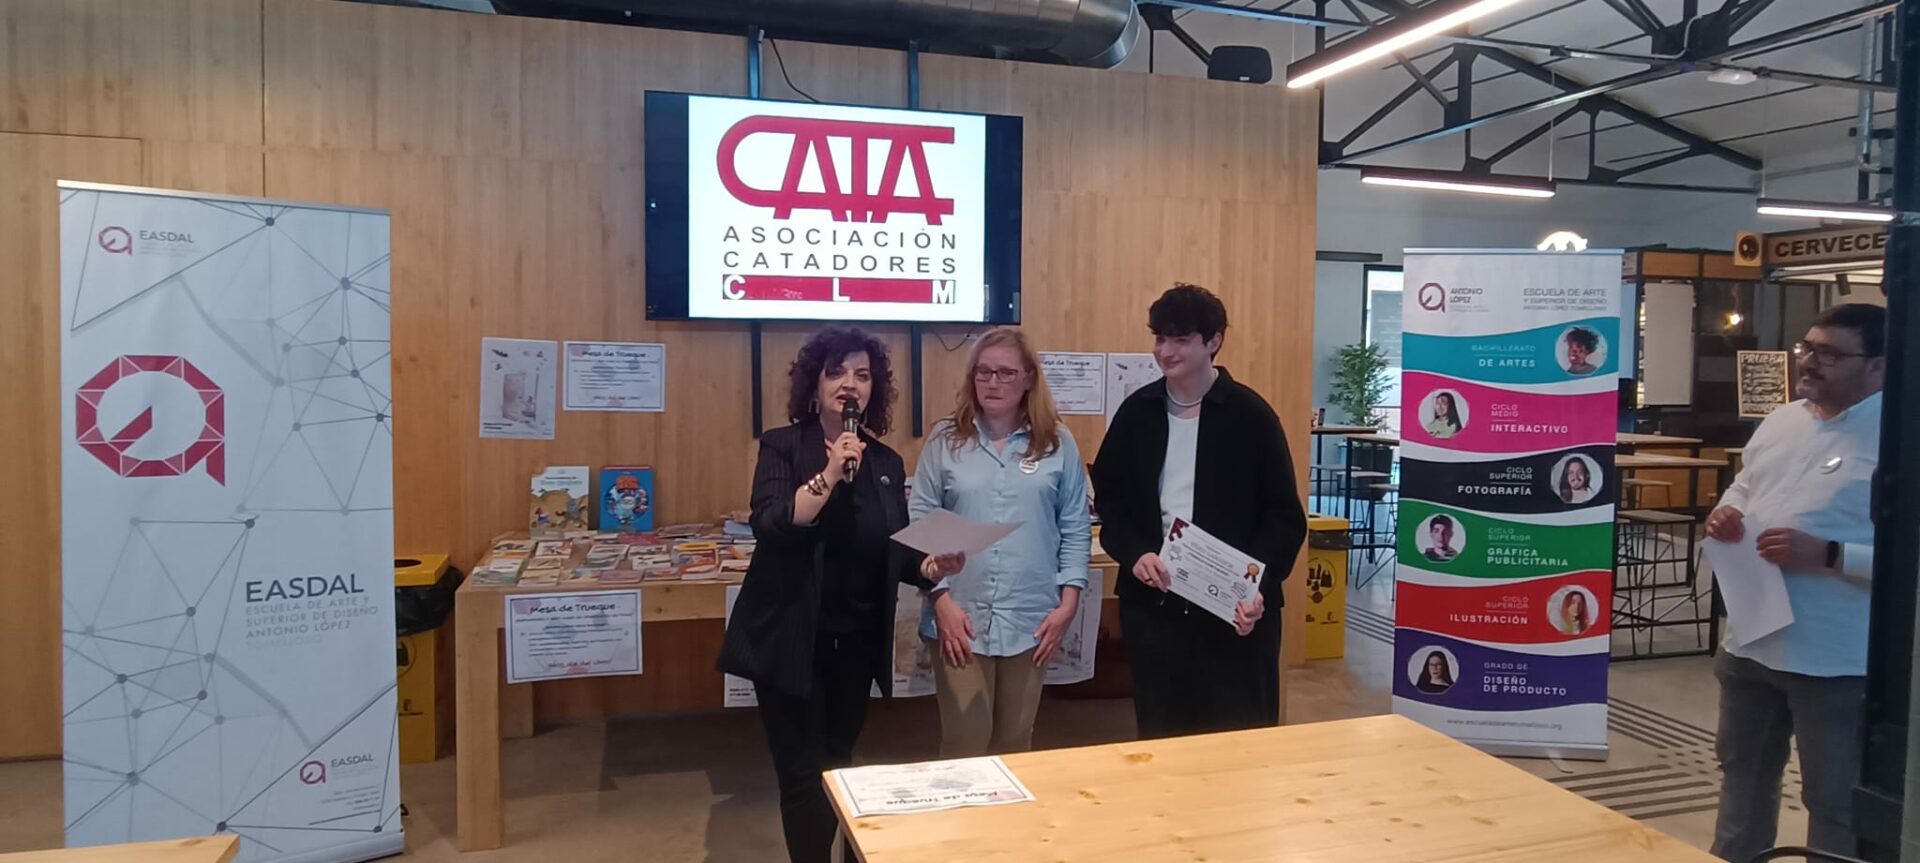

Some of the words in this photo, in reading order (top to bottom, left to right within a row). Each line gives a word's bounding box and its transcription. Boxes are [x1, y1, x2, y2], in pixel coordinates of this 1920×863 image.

[716, 114, 955, 225] CATA
[139, 230, 195, 244] EASDAL
[722, 225, 956, 249] ASOCIACIÓN
[1774, 232, 1886, 258] CERVECE
[722, 251, 956, 274] CATADORES
[1450, 287, 1483, 295] ANTONIO
[1523, 287, 1565, 296] ESCUELA
[1567, 287, 1580, 296] DE
[1582, 287, 1608, 297] ARTE
[1472, 344, 1537, 352] BACHILLERATO
[1479, 358, 1495, 367] DE
[1499, 359, 1536, 368] ARTES
[1490, 424, 1569, 434] INTERACTIVO
[1506, 466, 1533, 474] CICLO
[1489, 473, 1533, 481] SUPERIOR
[1457, 484, 1532, 496] FOTOGRAFÍA
[1488, 534, 1531, 542] SUPERIOR
[1487, 546, 1539, 557] GRÁFICA
[1487, 556, 1569, 567] PUBLICITARIA
[245, 572, 365, 603] EASDAL
[245, 601, 302, 616] ESCUELA
[306, 600, 323, 610] DE
[328, 597, 360, 608] ARTE
[529, 605, 556, 615] Mesa
[558, 604, 573, 613] de
[574, 602, 616, 614] Trueque
[245, 612, 307, 628] SUPERIOR
[312, 610, 328, 621] DE
[1450, 613, 1528, 625] ILUSTRACIÓN
[245, 623, 309, 639] ANTONIO
[1484, 662, 1514, 670] GRADO
[1517, 662, 1528, 671] DE
[1483, 674, 1527, 685] DISEÑO
[1483, 684, 1498, 693] DE
[1502, 685, 1567, 696] PRODUCTO
[331, 753, 375, 768] EASDAL
